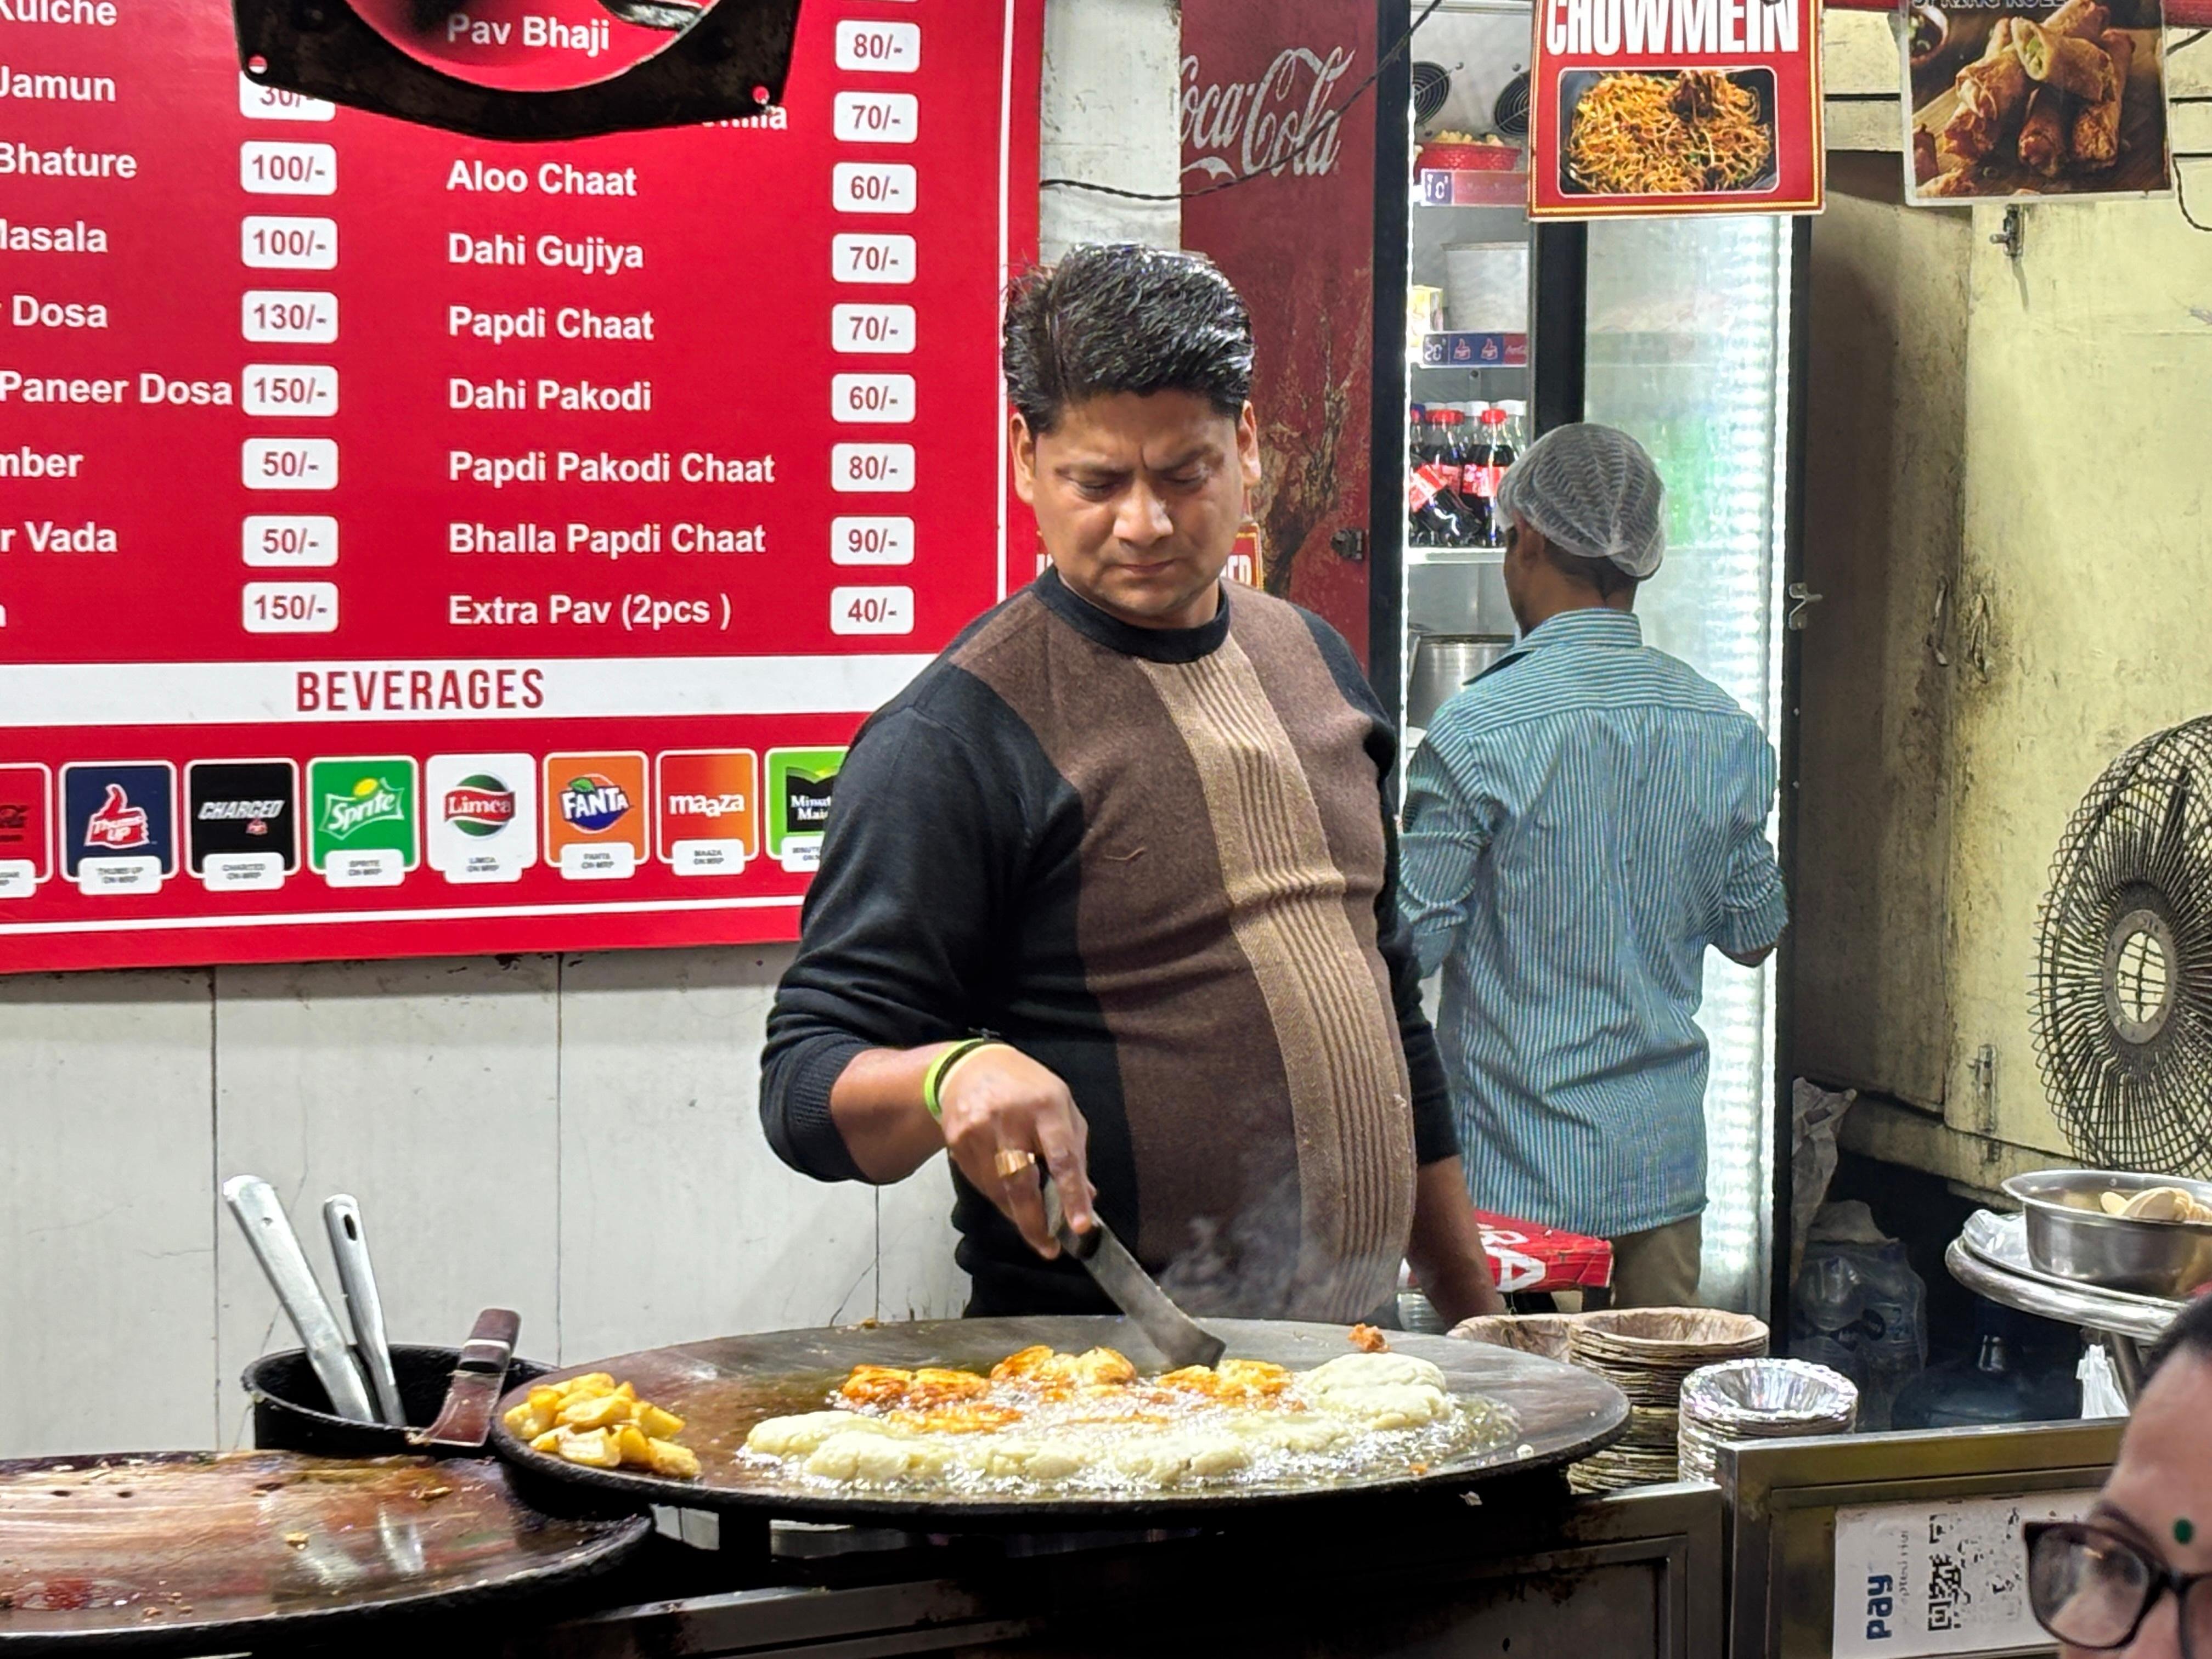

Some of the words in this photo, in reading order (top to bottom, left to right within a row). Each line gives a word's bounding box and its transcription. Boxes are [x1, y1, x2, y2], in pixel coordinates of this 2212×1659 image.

[447, 15, 510, 45] Pav
[523, 16, 610, 57] Bhaji
[1546, 0, 1799, 55] CHOWMEIN
[854, 33, 902, 60] 80/-
[0, 65, 116, 101] Jamun
[852, 105, 900, 130] 70/-
[0, 142, 137, 178] Bhature
[252, 155, 325, 183] 100/-
[447, 160, 528, 193] Aloo
[538, 163, 637, 196] Chaat
[851, 176, 899, 201] 60/-
[0, 218, 108, 252] asala
[253, 229, 326, 257] 100/-
[449, 233, 525, 264] Dahi
[537, 235, 644, 275] Gujiya
[850, 246, 898, 272] 70/-
[13, 295, 108, 328] Dosa
[254, 303, 326, 330] 130/-
[450, 306, 545, 344] Papdi
[557, 308, 654, 340] Chaat
[850, 317, 898, 341] 70/-
[0, 371, 129, 403] Paneer
[140, 373, 233, 405] Dosa
[255, 377, 326, 404] 150/-
[450, 379, 526, 409] Dahi
[538, 380, 651, 410] Pakodi
[849, 386, 898, 411] 60/-
[263, 452, 318, 477] 50/-
[450, 451, 545, 488] Papdi
[558, 452, 669, 482] Pakodi
[681, 453, 775, 482] Chaat
[849, 455, 898, 481] 80/-
[25, 521, 117, 552] Vada
[263, 528, 318, 555] 50/-
[450, 523, 555, 552] Bhalla
[568, 524, 660, 560] Papdi
[672, 523, 765, 553] Chaat
[848, 529, 897, 554] 90/-
[255, 595, 327, 620] 150/-
[450, 595, 538, 624] Extra
[550, 595, 611, 624] Pav
[848, 598, 896, 623] 40/-
[297, 668, 544, 712] BEVERAGES
[198, 800, 285, 820] CHARGED
[328, 789, 395, 832] Sprite
[448, 795, 511, 814] Limca
[562, 787, 630, 820] FANTA
[669, 794, 745, 817] maaza
[791, 794, 831, 808] Minut
